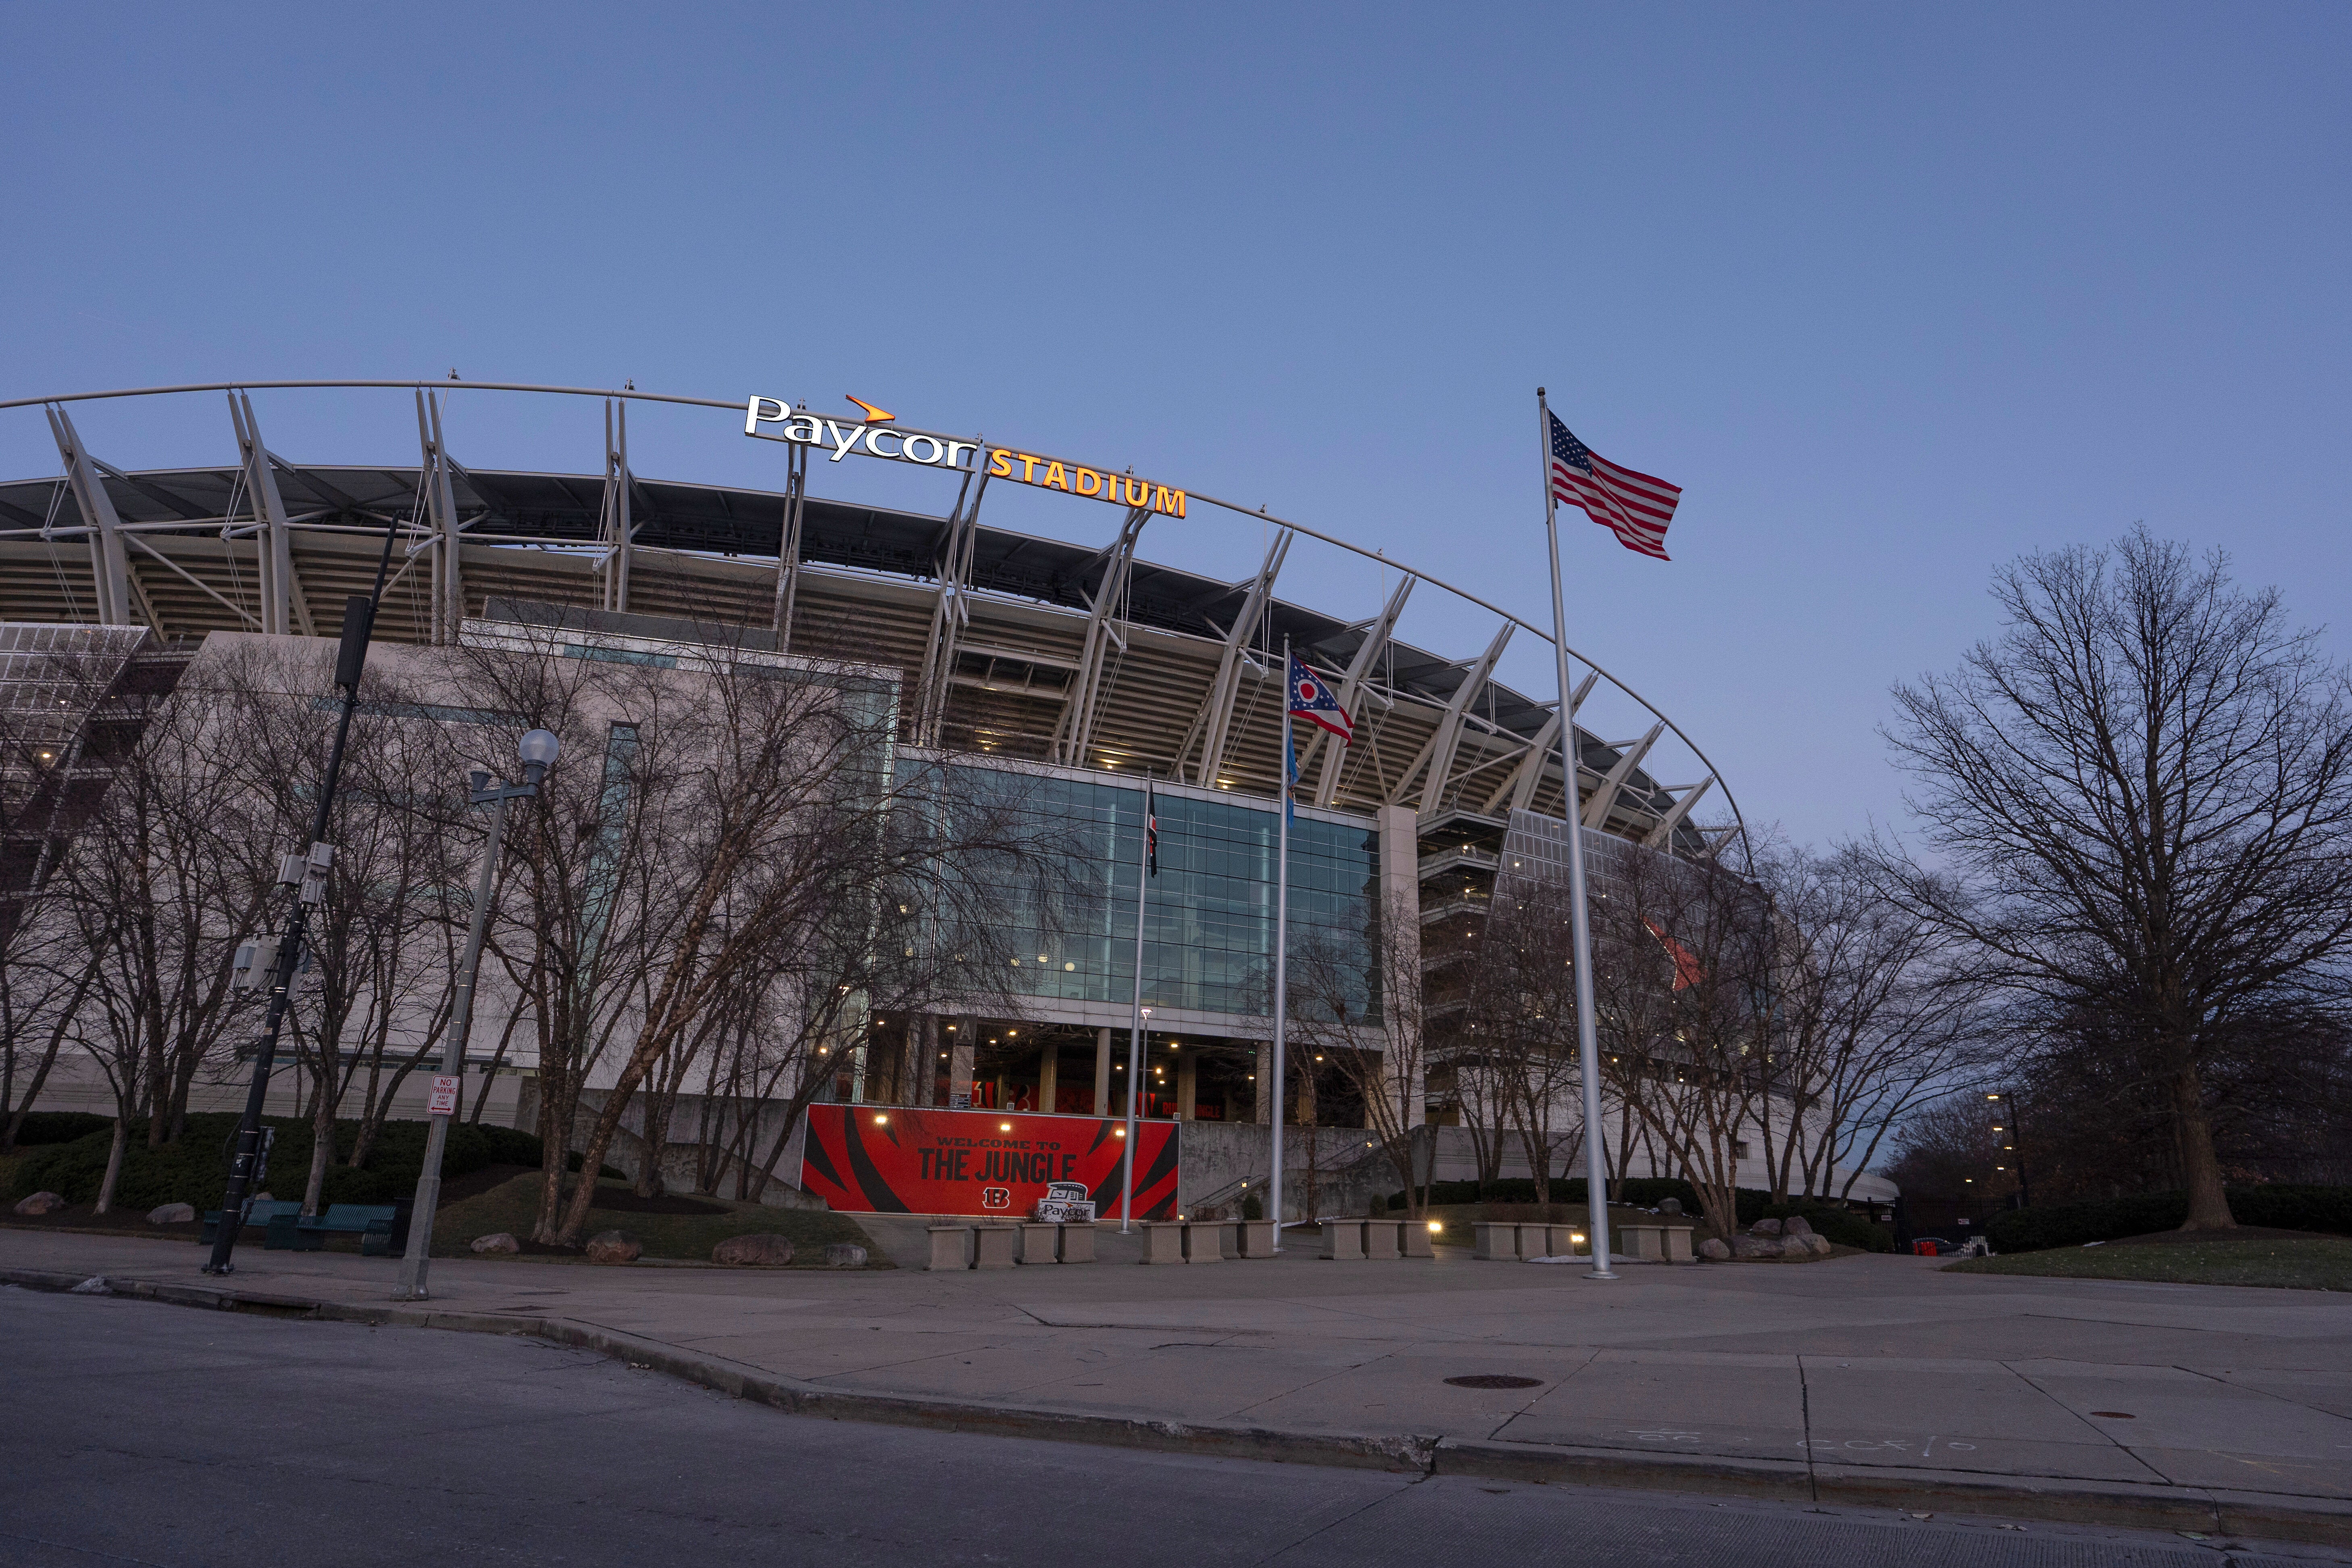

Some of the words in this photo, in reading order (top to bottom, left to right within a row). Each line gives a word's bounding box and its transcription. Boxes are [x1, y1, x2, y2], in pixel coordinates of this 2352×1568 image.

[744, 394, 977, 467] Paycor
[989, 448, 1186, 518] STADIUM
[433, 1086, 456, 1095] PARKING
[936, 1136, 1031, 1150] WELCOME
[1036, 1141, 1061, 1151] TO
[917, 1147, 971, 1181] THE
[974, 1150, 1077, 1184] JUNGLE
[1045, 1204, 1090, 1220] Paycor
